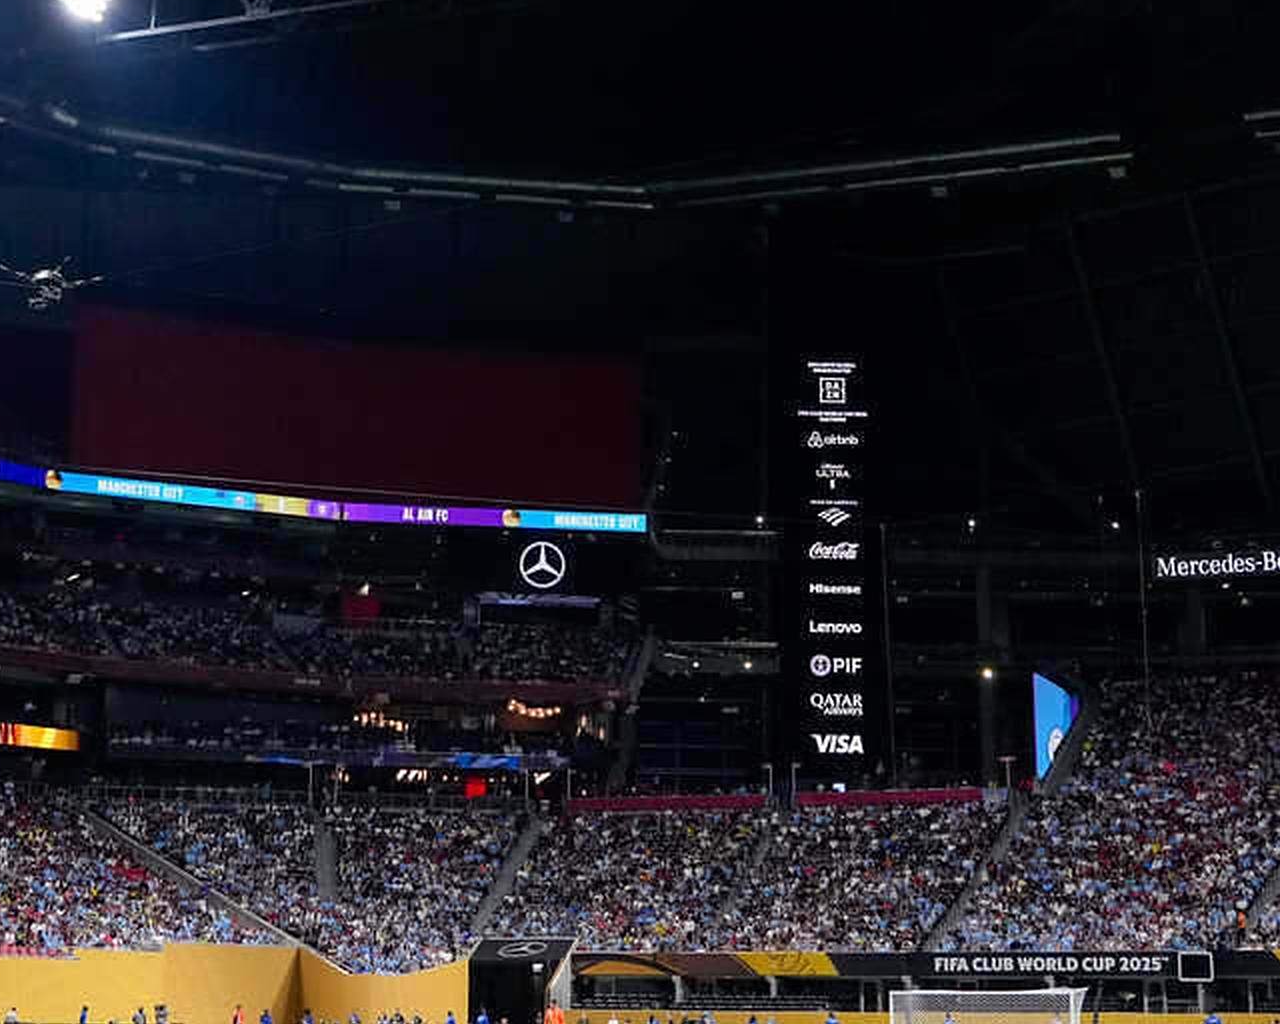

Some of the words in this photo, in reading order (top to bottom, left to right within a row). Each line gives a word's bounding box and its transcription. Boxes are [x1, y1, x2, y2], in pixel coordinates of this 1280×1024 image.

[809, 583, 862, 595] Hisense
[809, 620, 862, 633] Lenovo
[833, 658, 862, 673] PIF
[810, 693, 863, 709] QATAR
[809, 734, 864, 754] VISA
[934, 957, 969, 972] FIFA
[972, 957, 1014, 972] CLUB
[1018, 957, 1078, 972] WORLD
[1081, 957, 1115, 972] CUP
